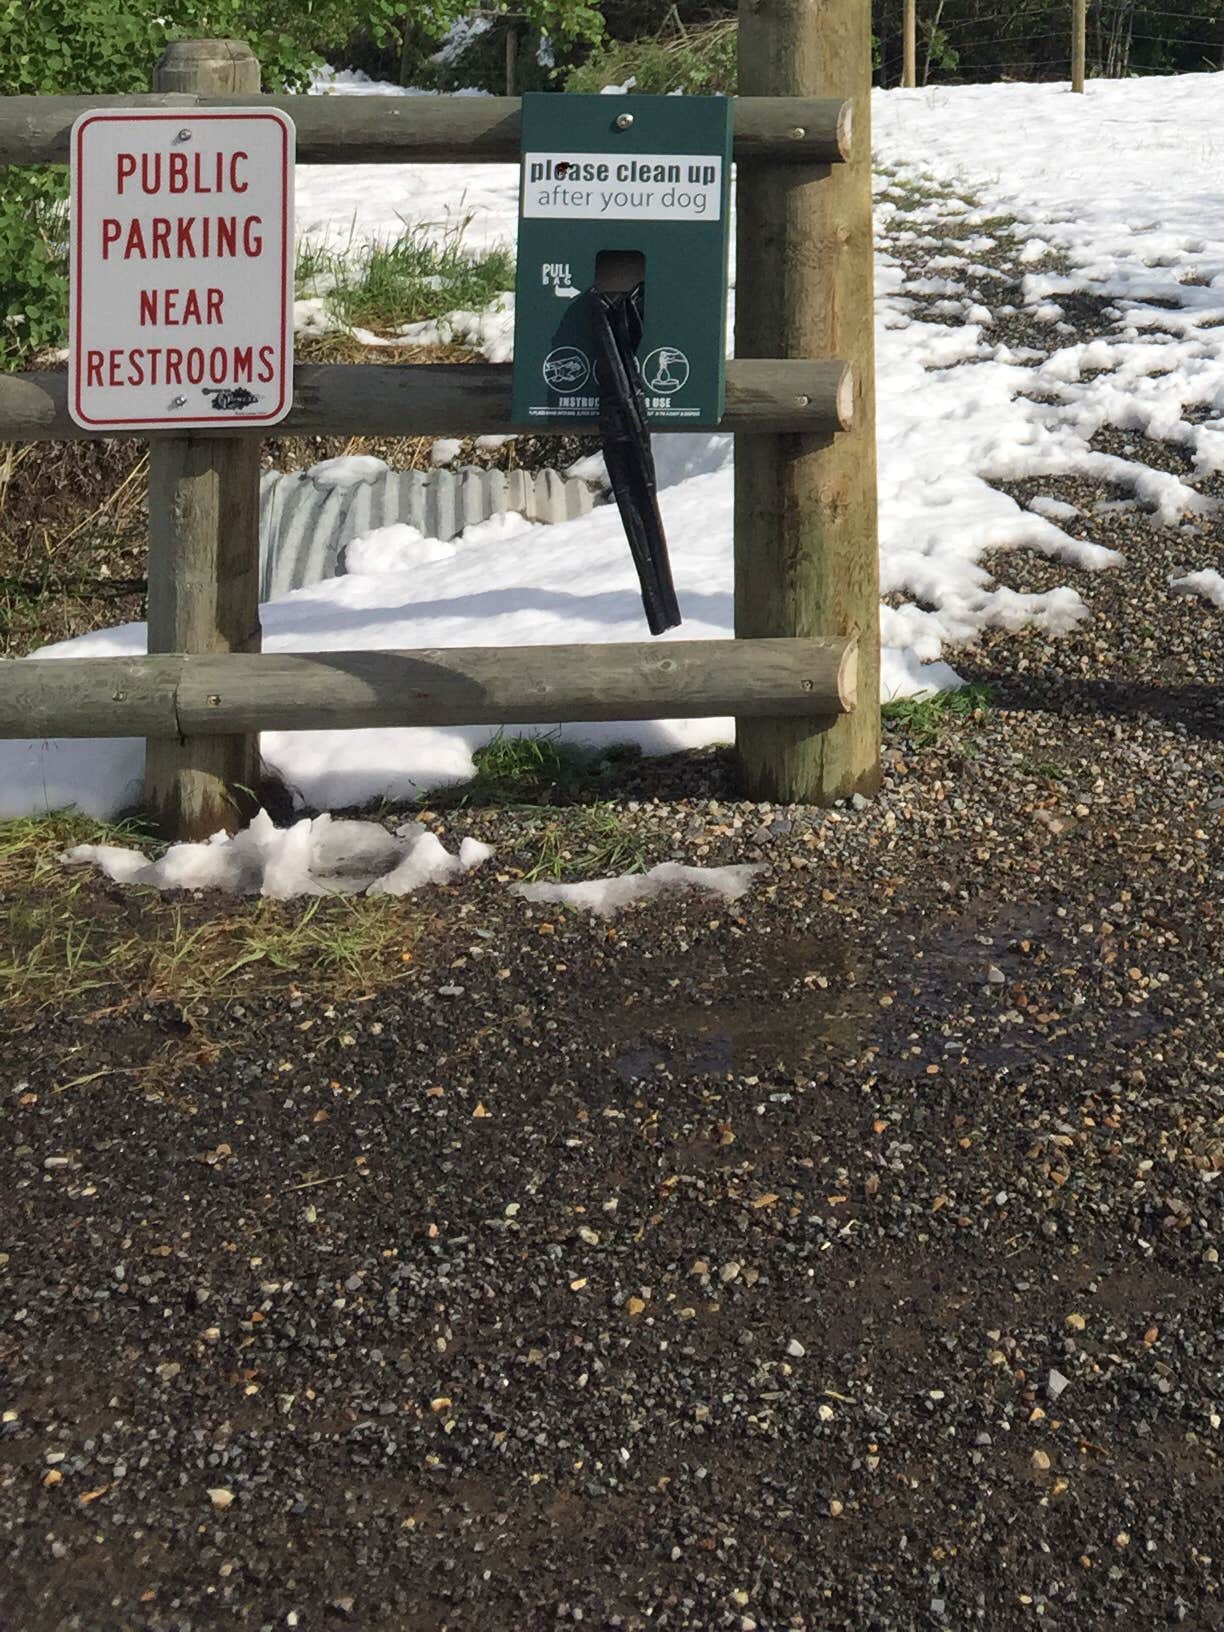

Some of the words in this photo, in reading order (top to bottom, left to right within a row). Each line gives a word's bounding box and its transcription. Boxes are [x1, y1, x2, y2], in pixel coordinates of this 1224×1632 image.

[117, 151, 249, 195] PUBLIC
[530, 159, 609, 183] please
[616, 161, 681, 183] clean
[688, 165, 715, 186] up
[538, 185, 594, 207] after
[600, 192, 655, 212] your
[661, 188, 707, 214] dog
[102, 216, 263, 259] PARKING
[542, 263, 571, 277] PULL
[139, 288, 224, 326] NEAR
[86, 345, 275, 387] RESTROOMS
[652, 397, 671, 408] USE
